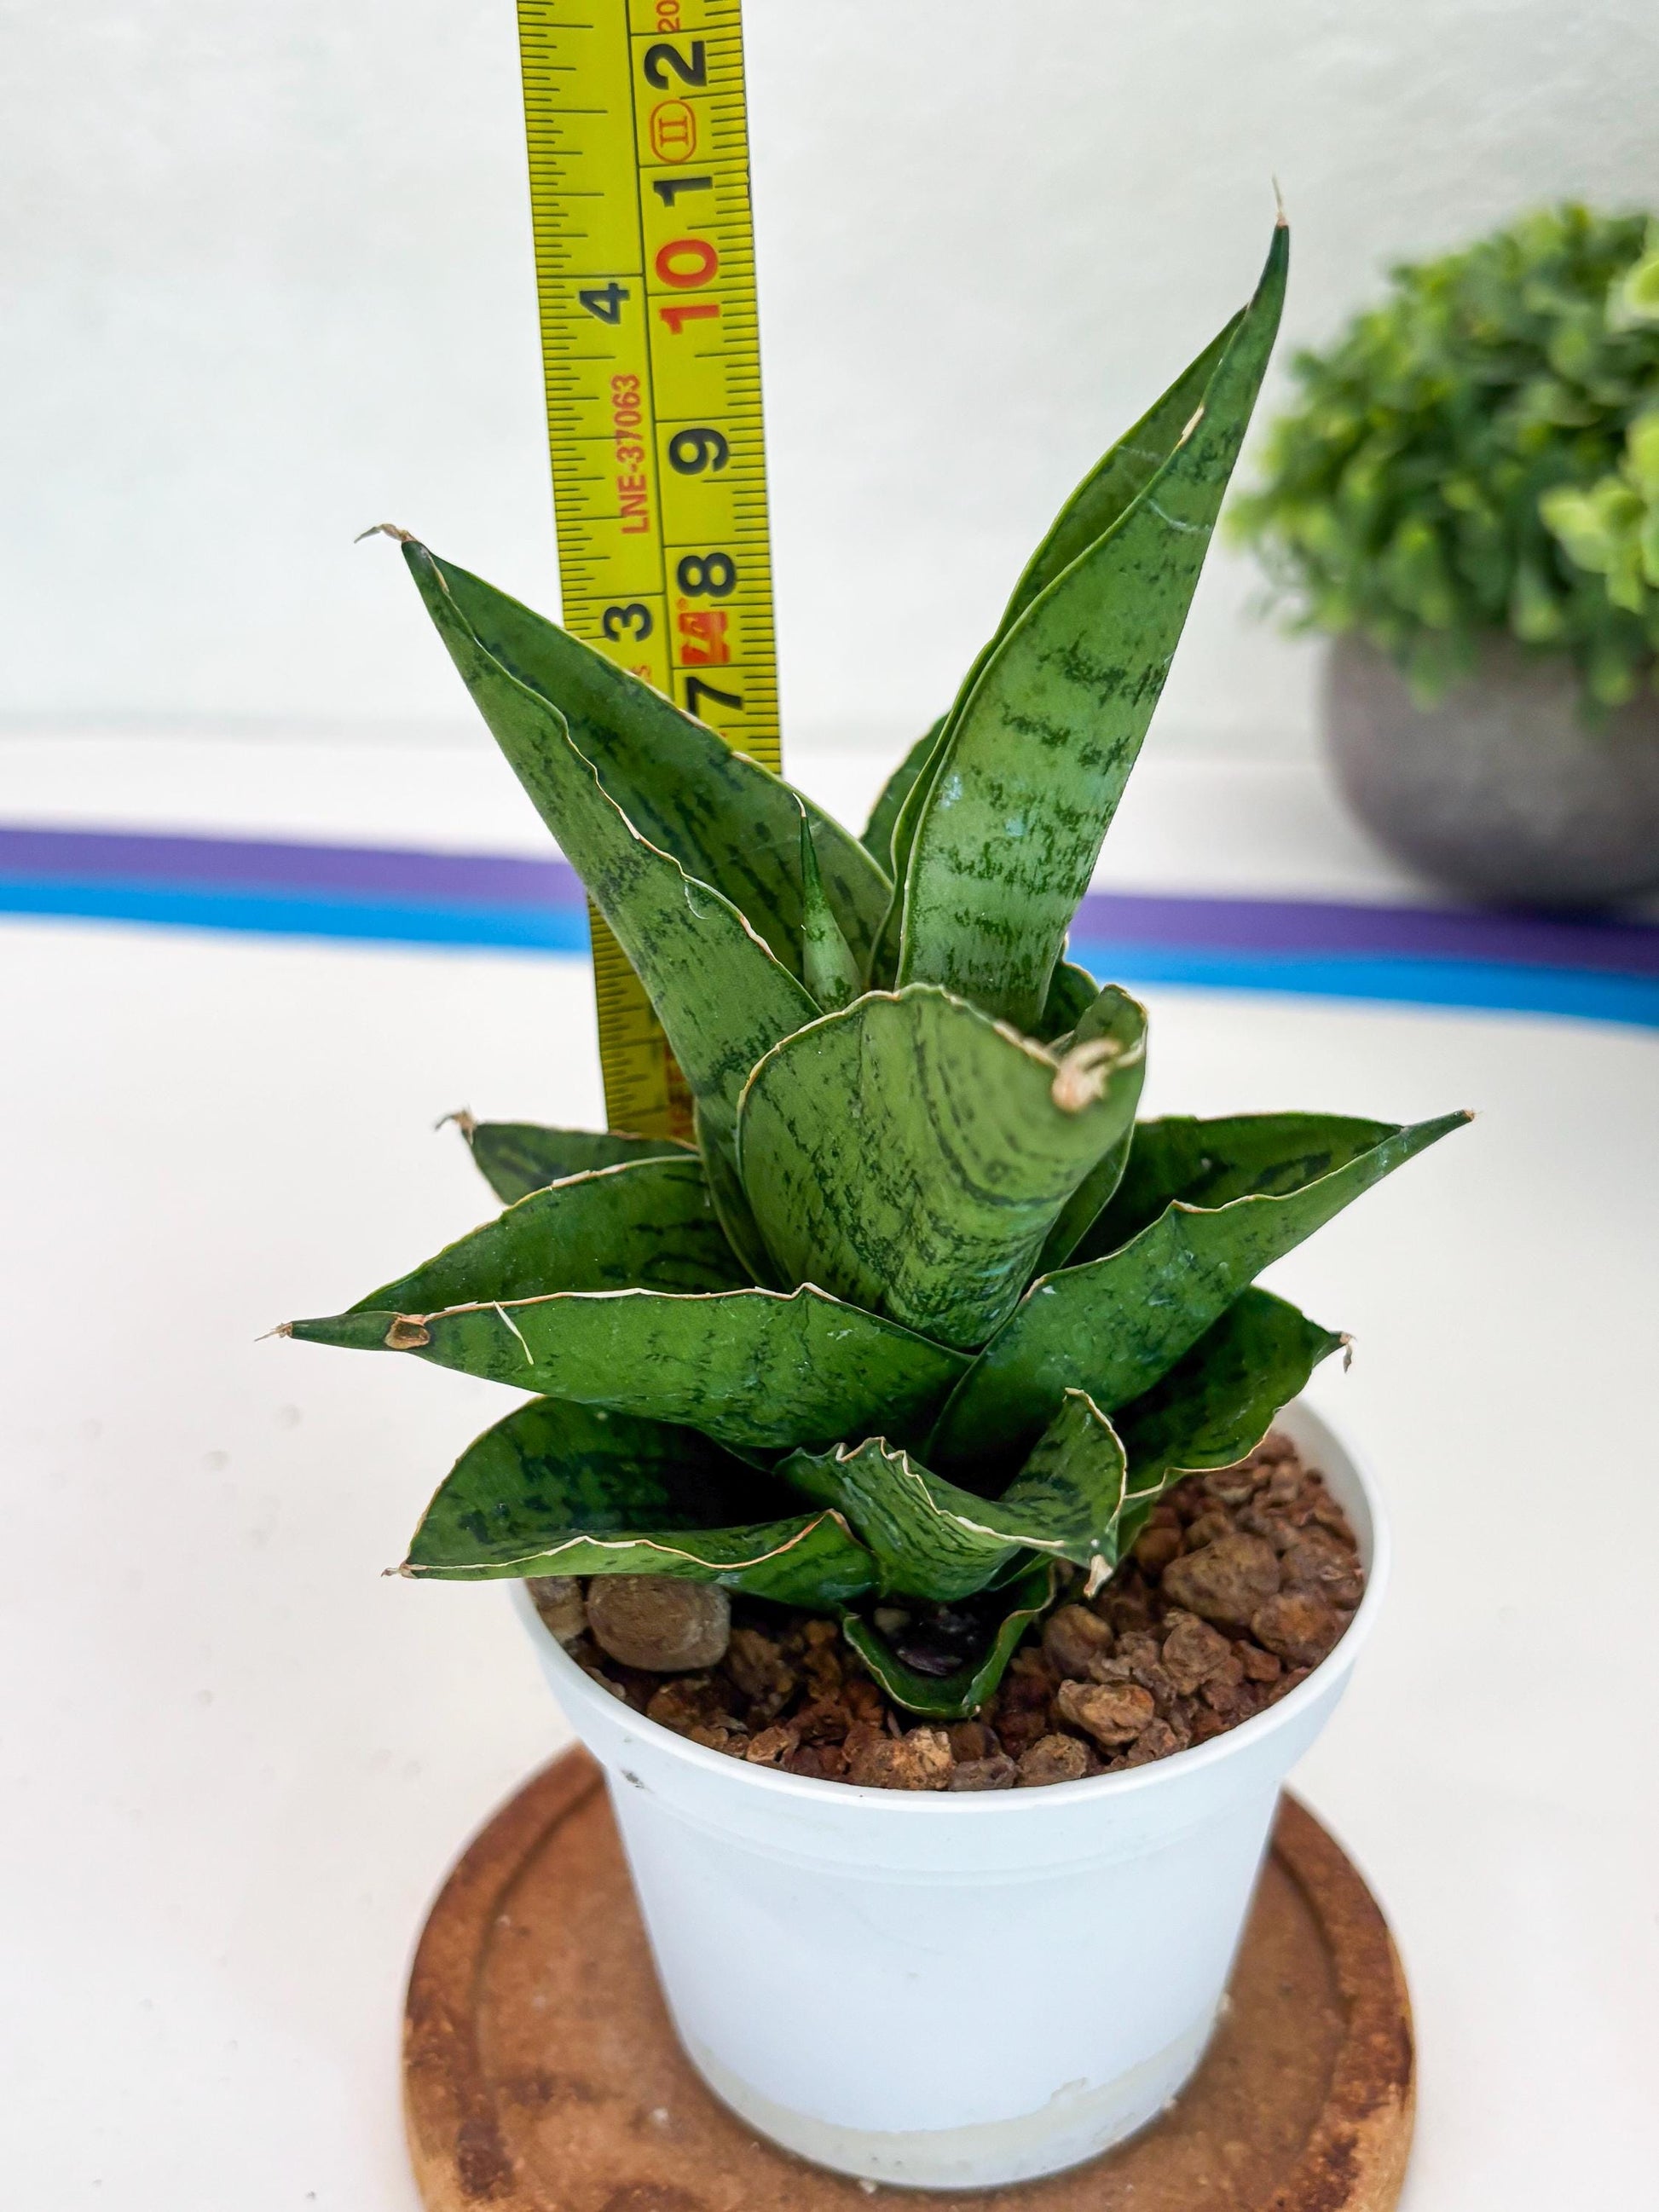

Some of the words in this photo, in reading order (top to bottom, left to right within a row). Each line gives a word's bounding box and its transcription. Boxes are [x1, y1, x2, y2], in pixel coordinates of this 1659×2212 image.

[644, 40, 708, 90] 2
[653, 176, 714, 208] 1
[579, 283, 631, 325] 4
[610, 374, 651, 534] LNE-37063
[669, 428, 730, 476] 9
[677, 552, 737, 598] 8
[604, 603, 654, 643] 3
[686, 677, 743, 716] 7
